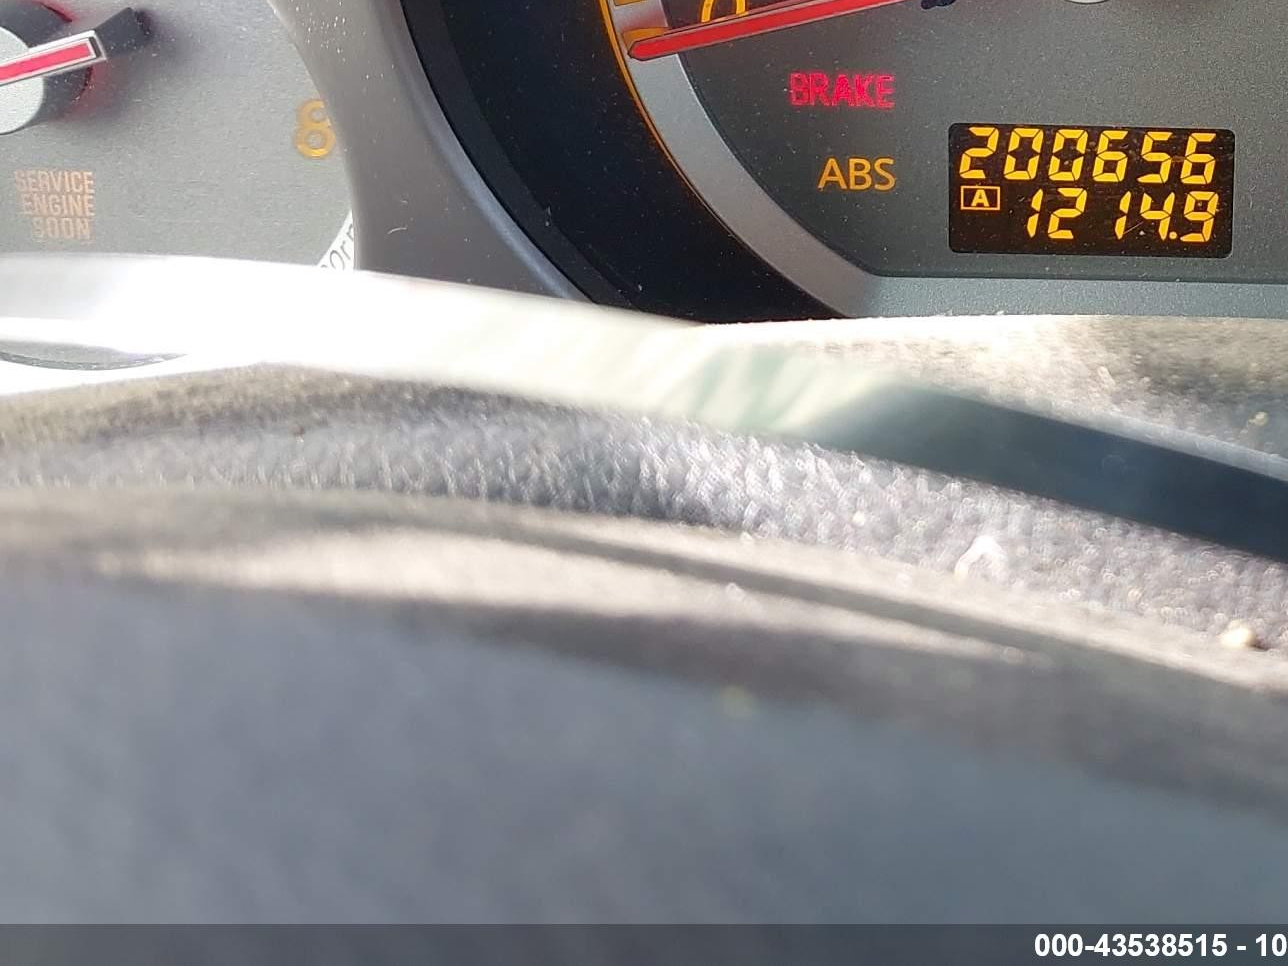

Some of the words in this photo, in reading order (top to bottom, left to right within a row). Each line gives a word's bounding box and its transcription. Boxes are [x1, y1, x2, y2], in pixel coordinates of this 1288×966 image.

[788, 72, 895, 110] BRAKE
[293, 99, 336, 159] 8
[958, 126, 1217, 184] 200656
[15, 170, 95, 193] SERVICE
[818, 157, 896, 191] ABS
[21, 193, 95, 216] ENGINE
[970, 188, 991, 208] A
